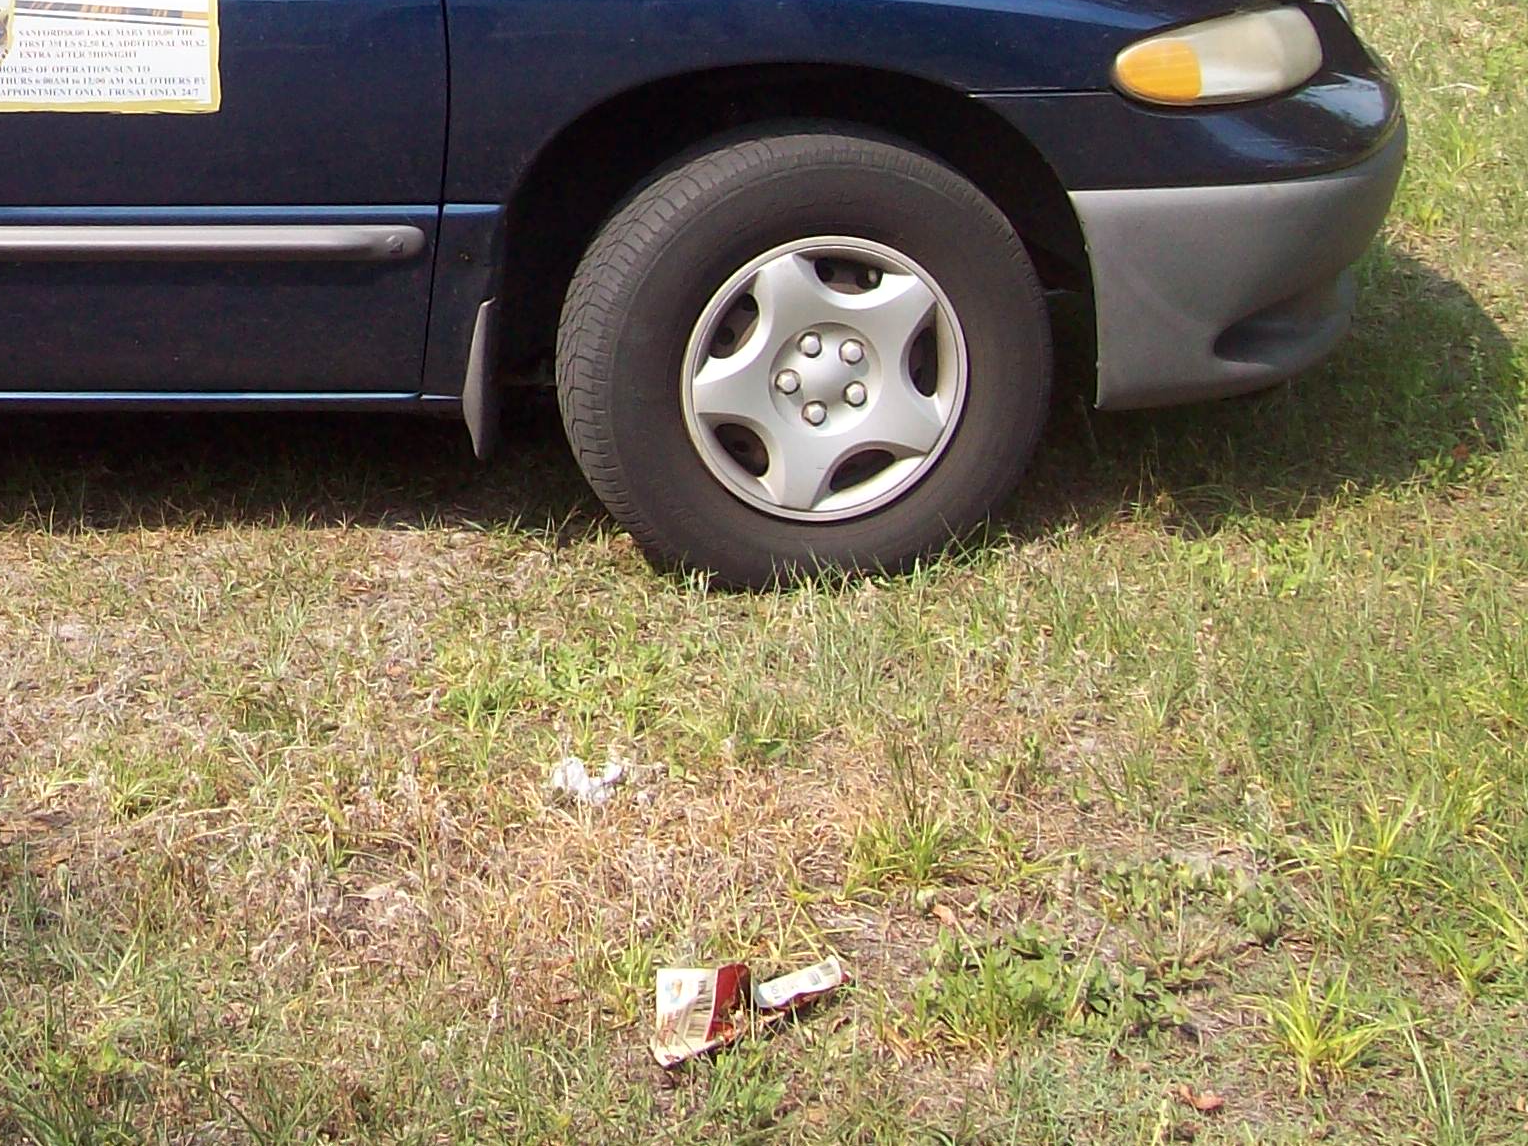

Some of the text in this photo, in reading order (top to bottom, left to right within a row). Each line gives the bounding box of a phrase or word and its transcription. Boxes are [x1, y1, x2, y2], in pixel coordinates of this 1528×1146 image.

[87, 29, 112, 38] LAKE
[116, 29, 143, 38] MARY
[18, 50, 52, 59] EXTRA
[0, 65, 34, 74] HOURS
[35, 65, 49, 74] OF
[51, 65, 112, 74] OPERATION
[0, 76, 33, 85] THURS
[150, 76, 191, 85] OTHERS
[0, 87, 72, 97] APPOINTMENT
